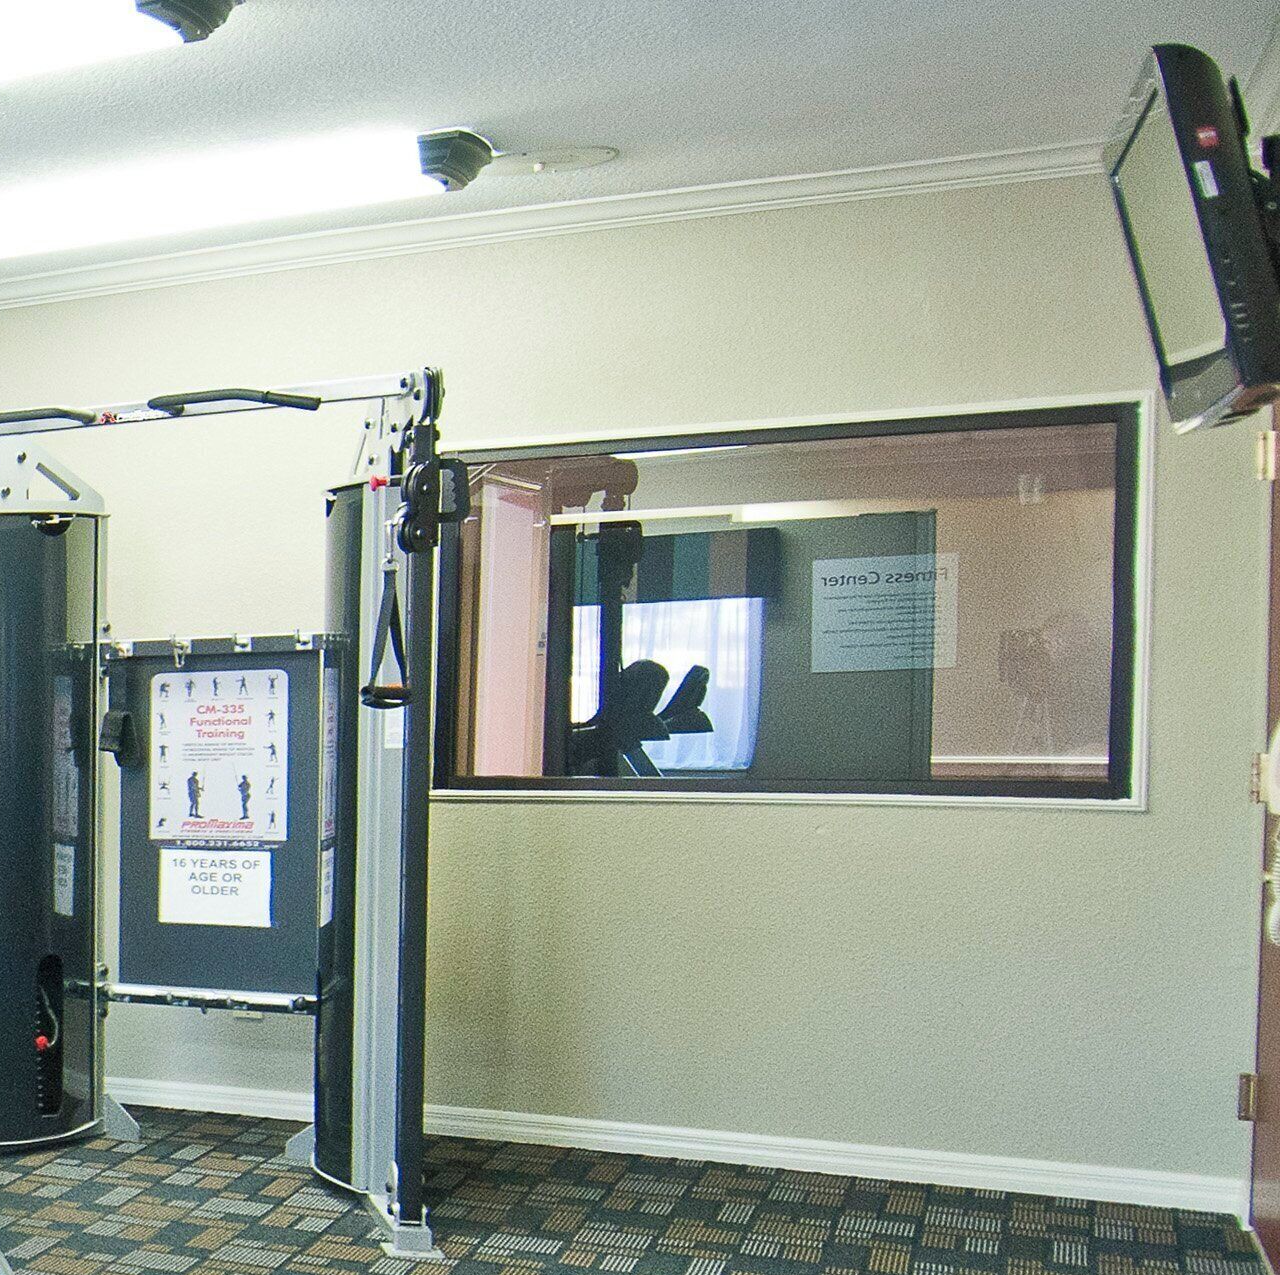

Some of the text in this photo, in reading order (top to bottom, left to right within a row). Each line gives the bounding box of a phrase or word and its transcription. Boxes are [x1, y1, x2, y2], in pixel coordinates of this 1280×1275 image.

[196, 704, 245, 715] CM-335
[189, 716, 252, 727] Functional
[196, 729, 245, 740] Training
[191, 858, 237, 869] YEARS
[241, 859, 261, 870] OF
[188, 872, 242, 883] AGE OR
[191, 885, 239, 896] OLDER
